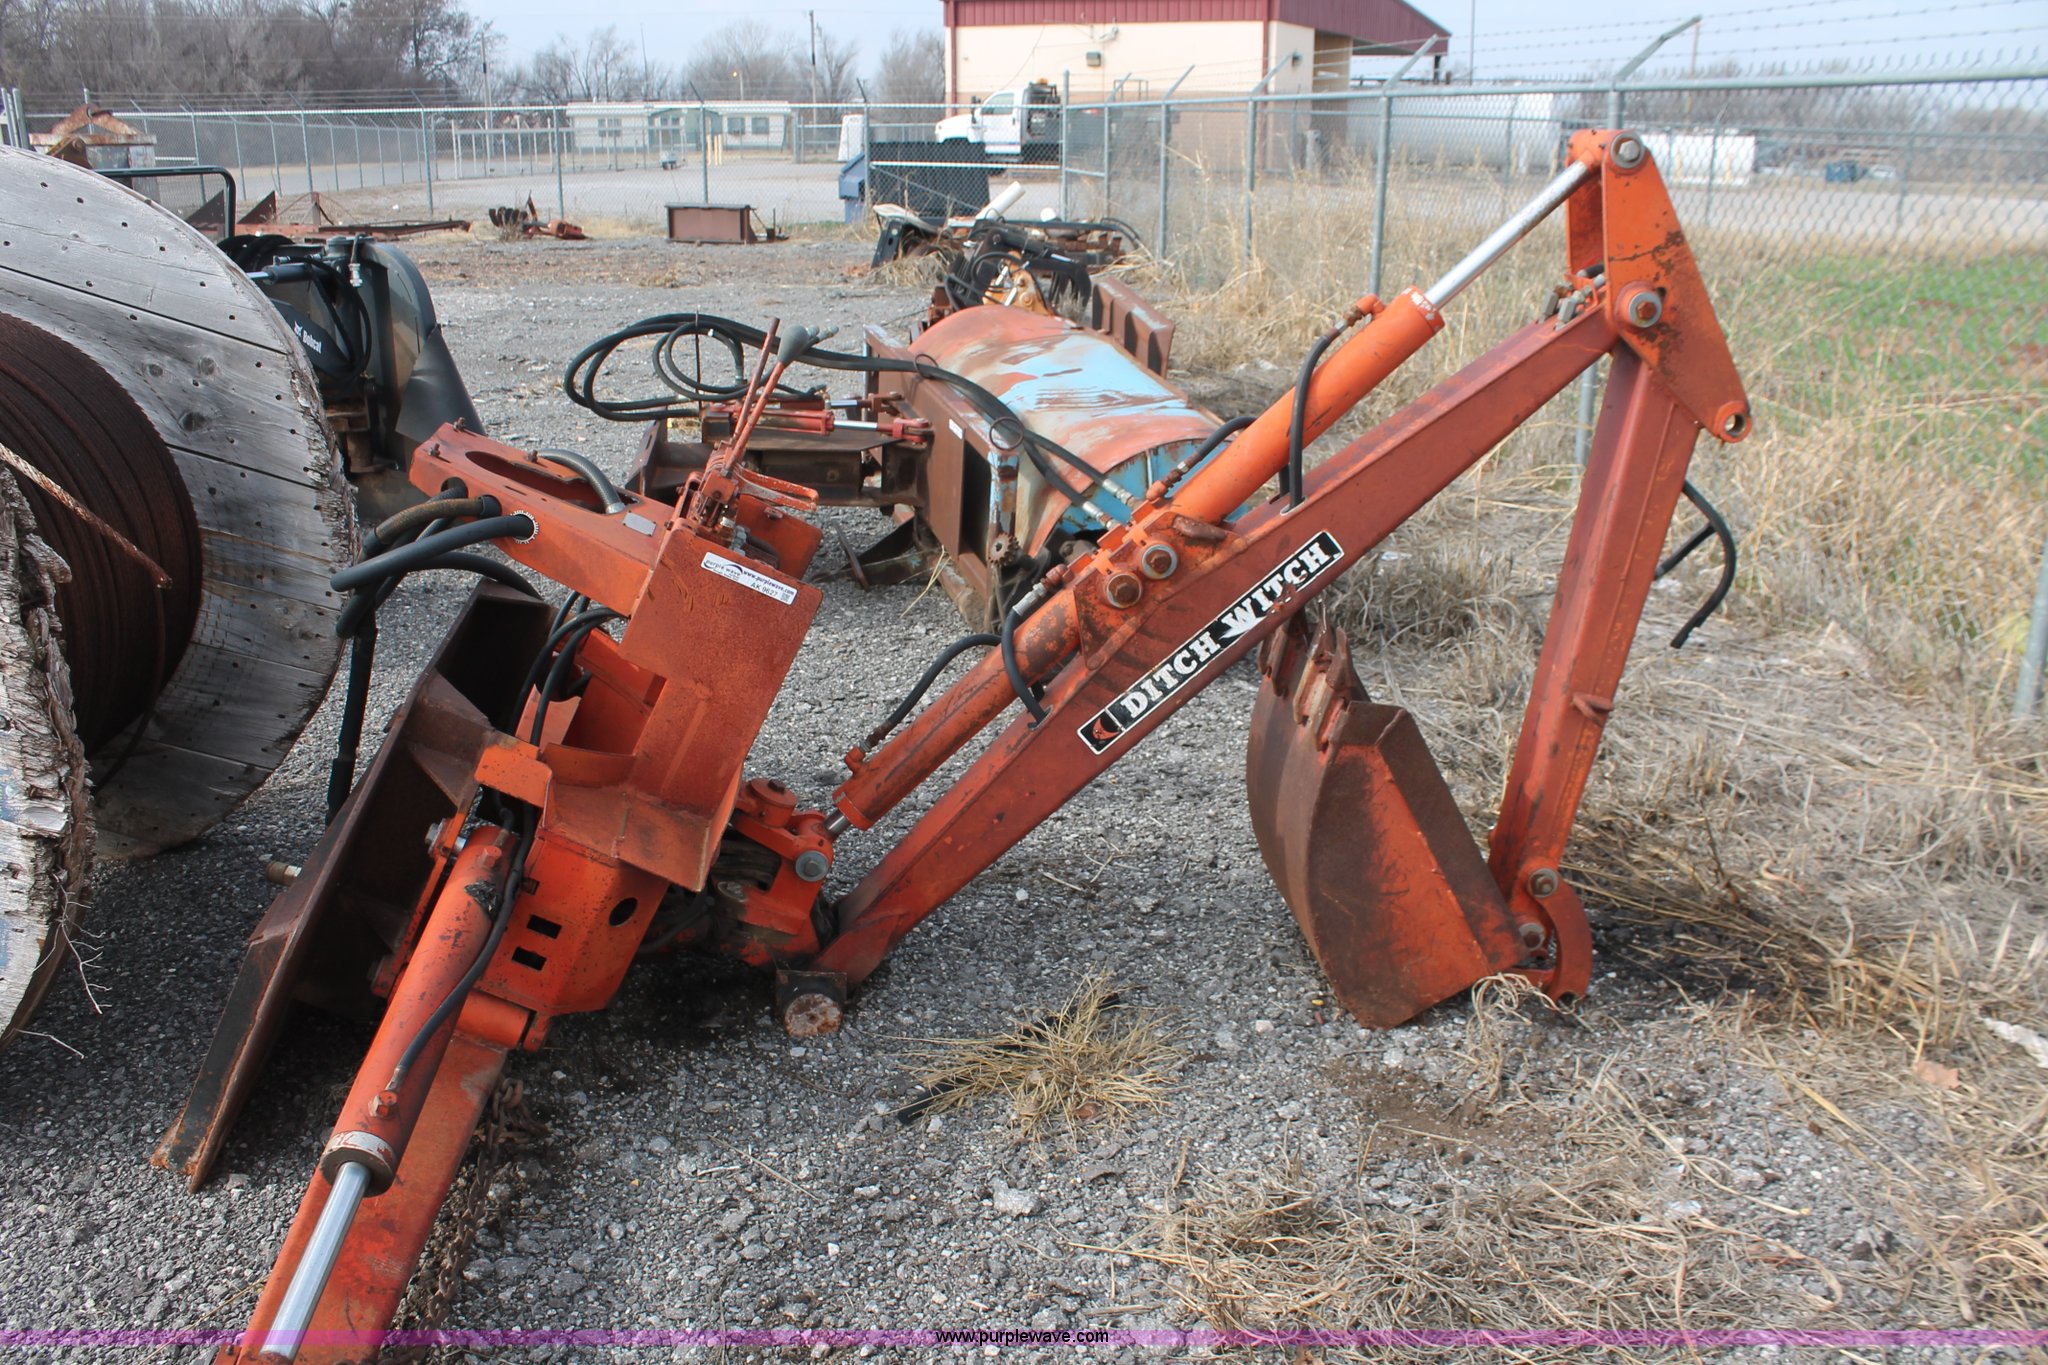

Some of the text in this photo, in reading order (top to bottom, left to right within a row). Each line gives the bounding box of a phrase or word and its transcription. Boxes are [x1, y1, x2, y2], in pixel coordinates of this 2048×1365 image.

[303, 330, 321, 354] Bobcat
[743, 570, 795, 596] www.purplewave.com
[750, 582, 778, 597] AK 9627
[1119, 541, 1331, 719] DITCH WITCH
